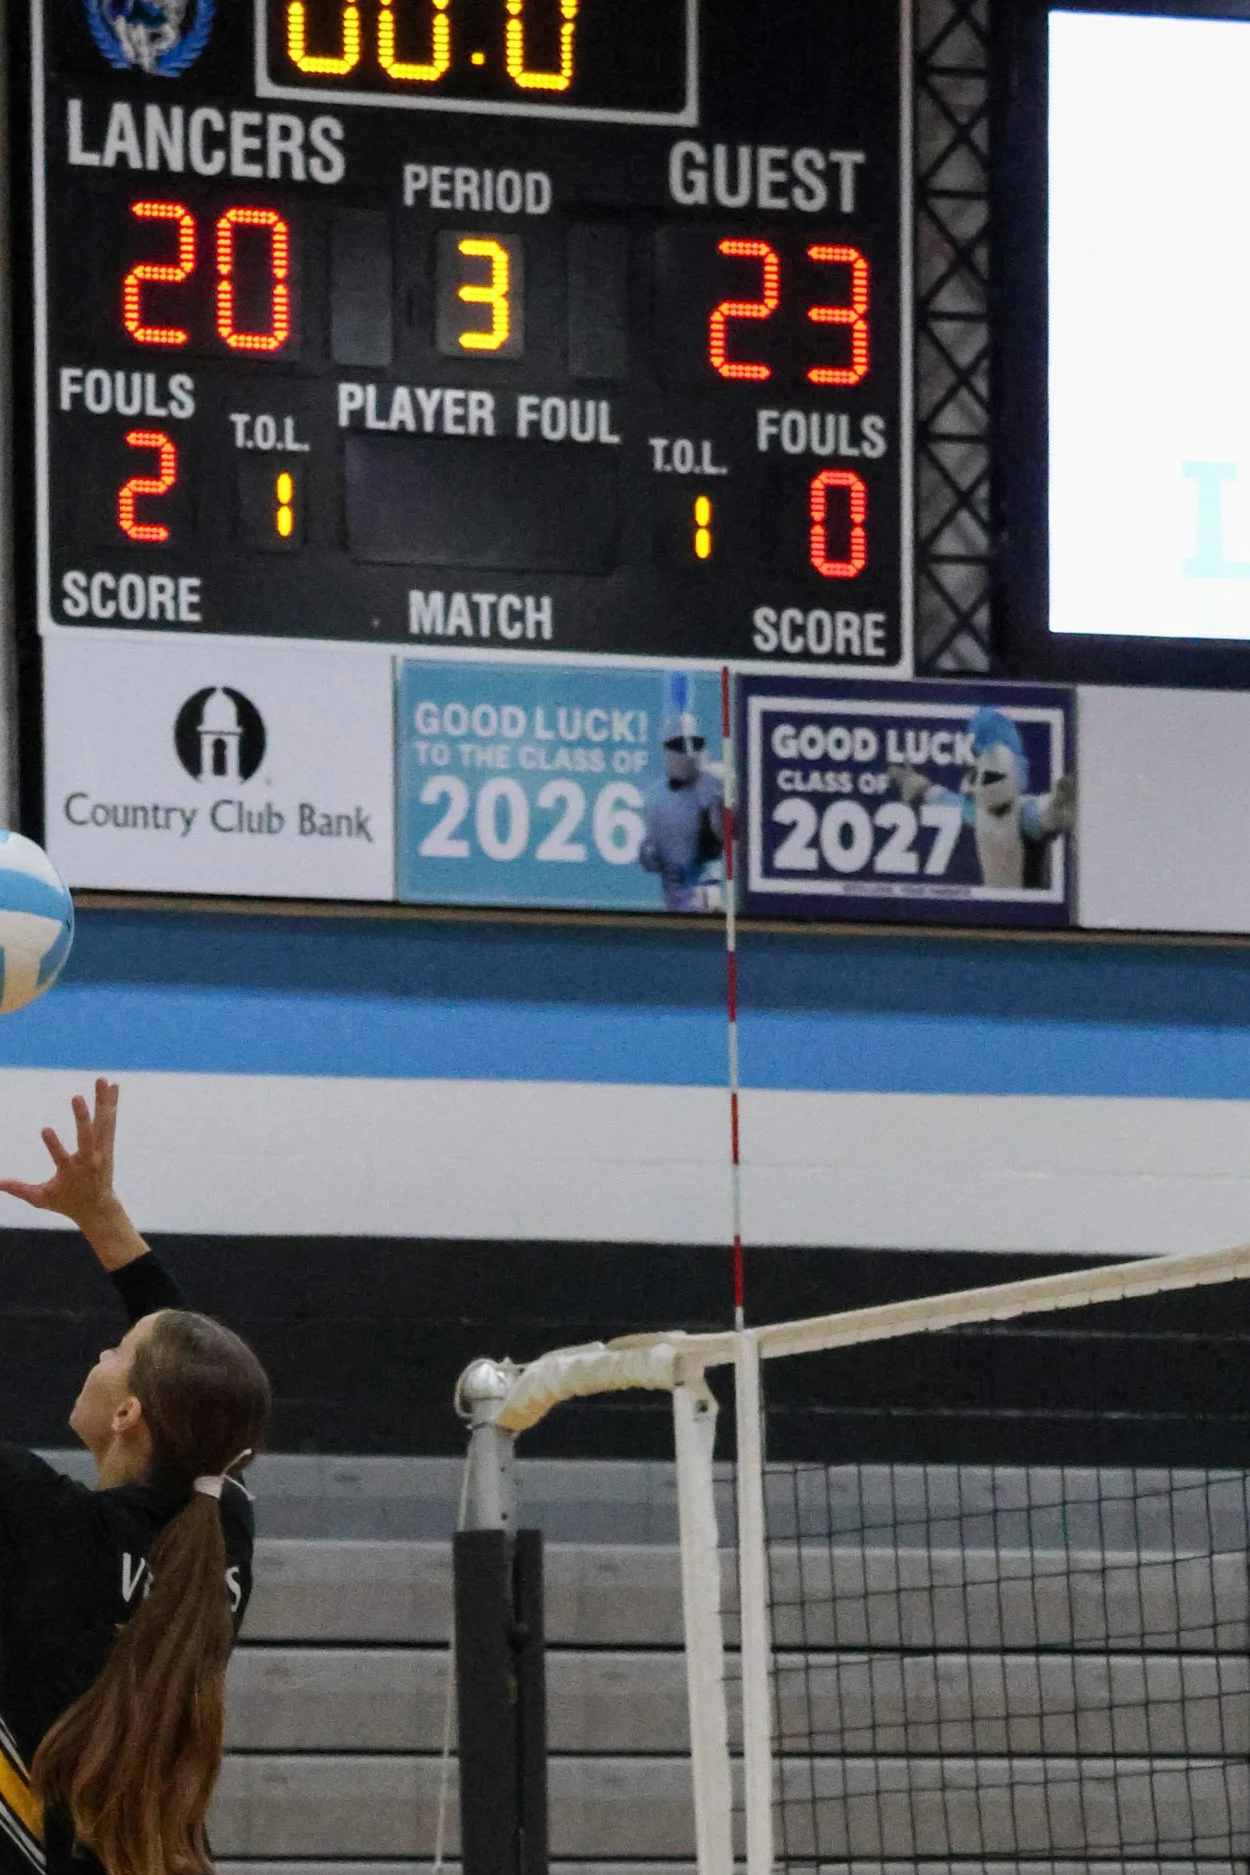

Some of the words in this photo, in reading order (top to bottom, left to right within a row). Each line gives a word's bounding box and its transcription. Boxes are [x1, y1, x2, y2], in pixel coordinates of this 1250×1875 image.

[67, 99, 346, 184] LANCERS
[403, 164, 552, 216] PERIOD
[669, 141, 868, 213] GUEST
[122, 202, 290, 352] 20
[457, 239, 511, 351] 3
[709, 239, 871, 386] 23
[59, 366, 196, 420] FOULS
[338, 383, 495, 438] PLAYER
[517, 396, 622, 446] FOUL
[230, 413, 310, 453] T.O.L.
[650, 438, 728, 478] T.O.L.
[757, 410, 887, 459] FOULS
[118, 432, 177, 543] 2
[277, 472, 294, 539] 1
[695, 495, 711, 560] 1
[810, 470, 868, 579] 0
[62, 570, 201, 624] SCORE
[409, 590, 553, 642] MATCH
[753, 608, 887, 657] SCORE
[414, 701, 527, 738] GOOD
[534, 706, 649, 743] LUCK!
[771, 723, 878, 762] GOOD
[886, 729, 977, 766] LUCK
[415, 741, 450, 767] TO
[458, 743, 511, 769] THE
[517, 746, 607, 773] CLASS
[613, 750, 649, 774] OF
[776, 769, 854, 794] CLASS
[858, 772, 891, 796] OF
[64, 792, 198, 838] Country
[211, 799, 286, 834] Club
[298, 802, 374, 843] Bank
[417, 774, 647, 865] 2026
[771, 798, 963, 876] 2027
